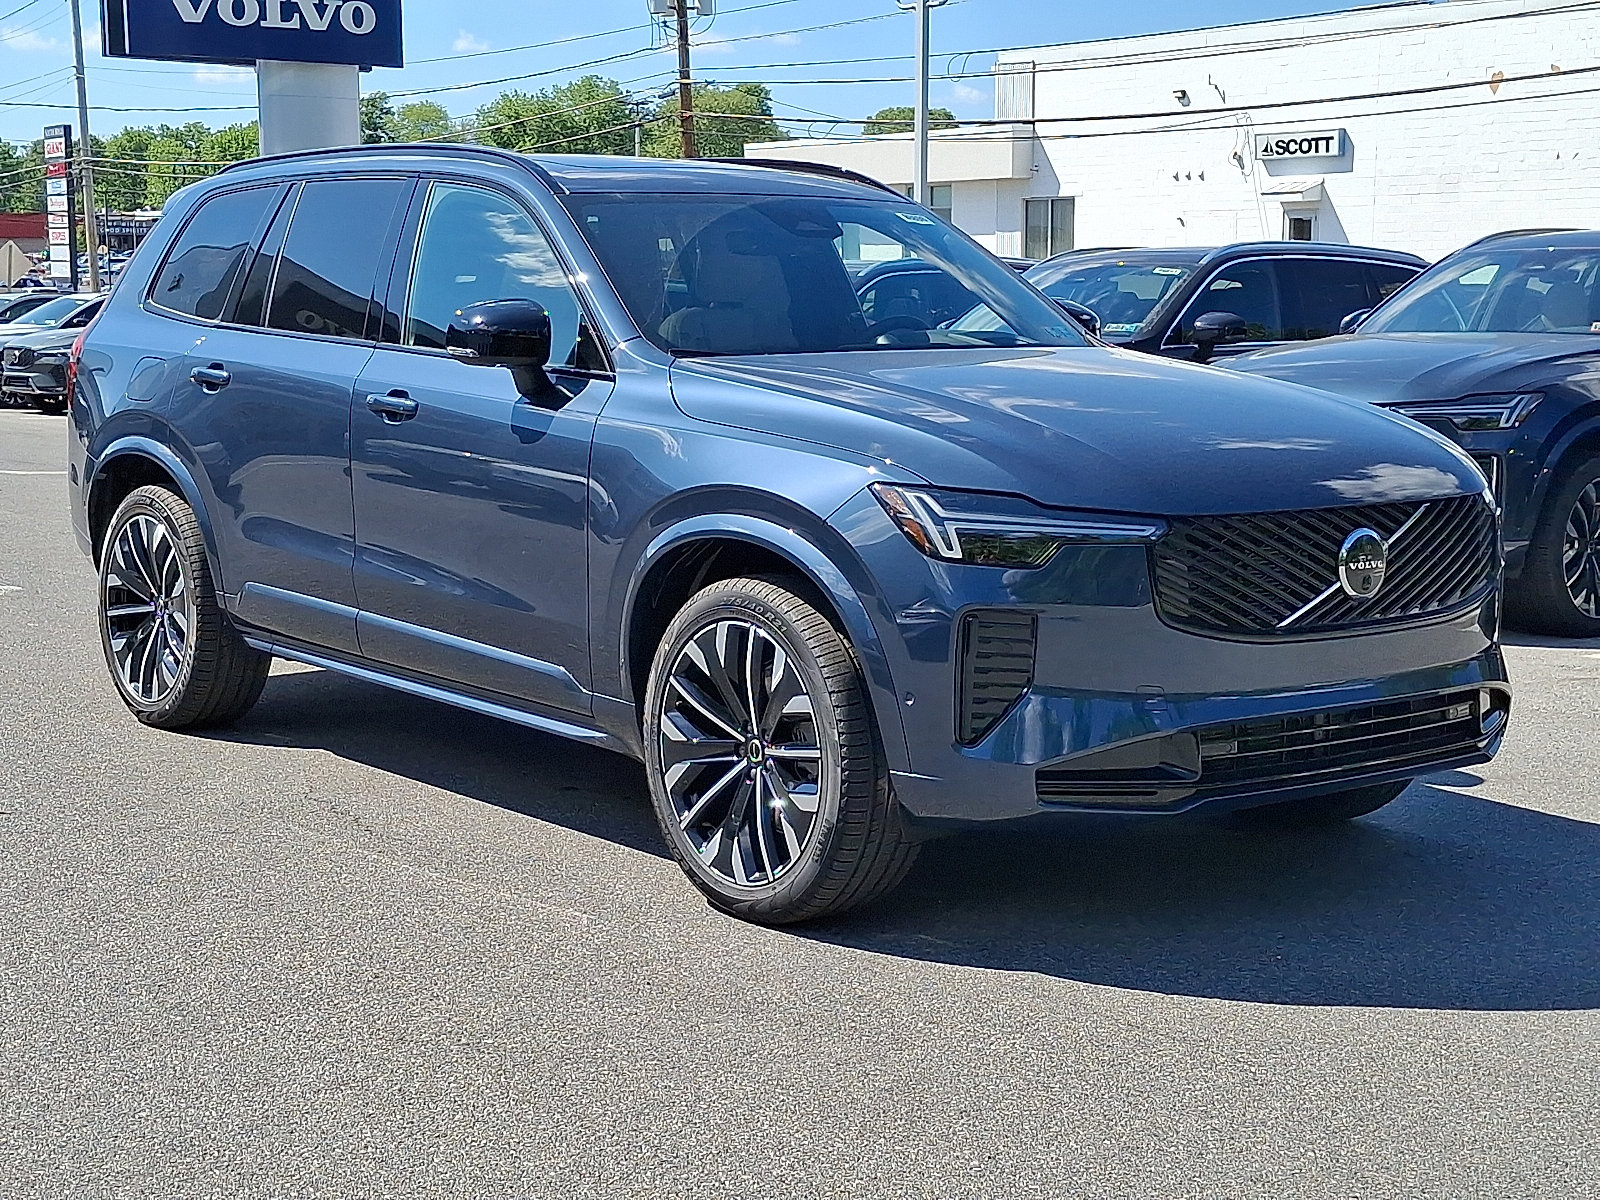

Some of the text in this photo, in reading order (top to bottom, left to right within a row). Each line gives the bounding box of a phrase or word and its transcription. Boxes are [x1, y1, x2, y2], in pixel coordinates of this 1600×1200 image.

[173, 0, 377, 35] VOLVO
[1275, 136, 1334, 156] SCOTT
[1349, 560, 1384, 570] VOLVO
